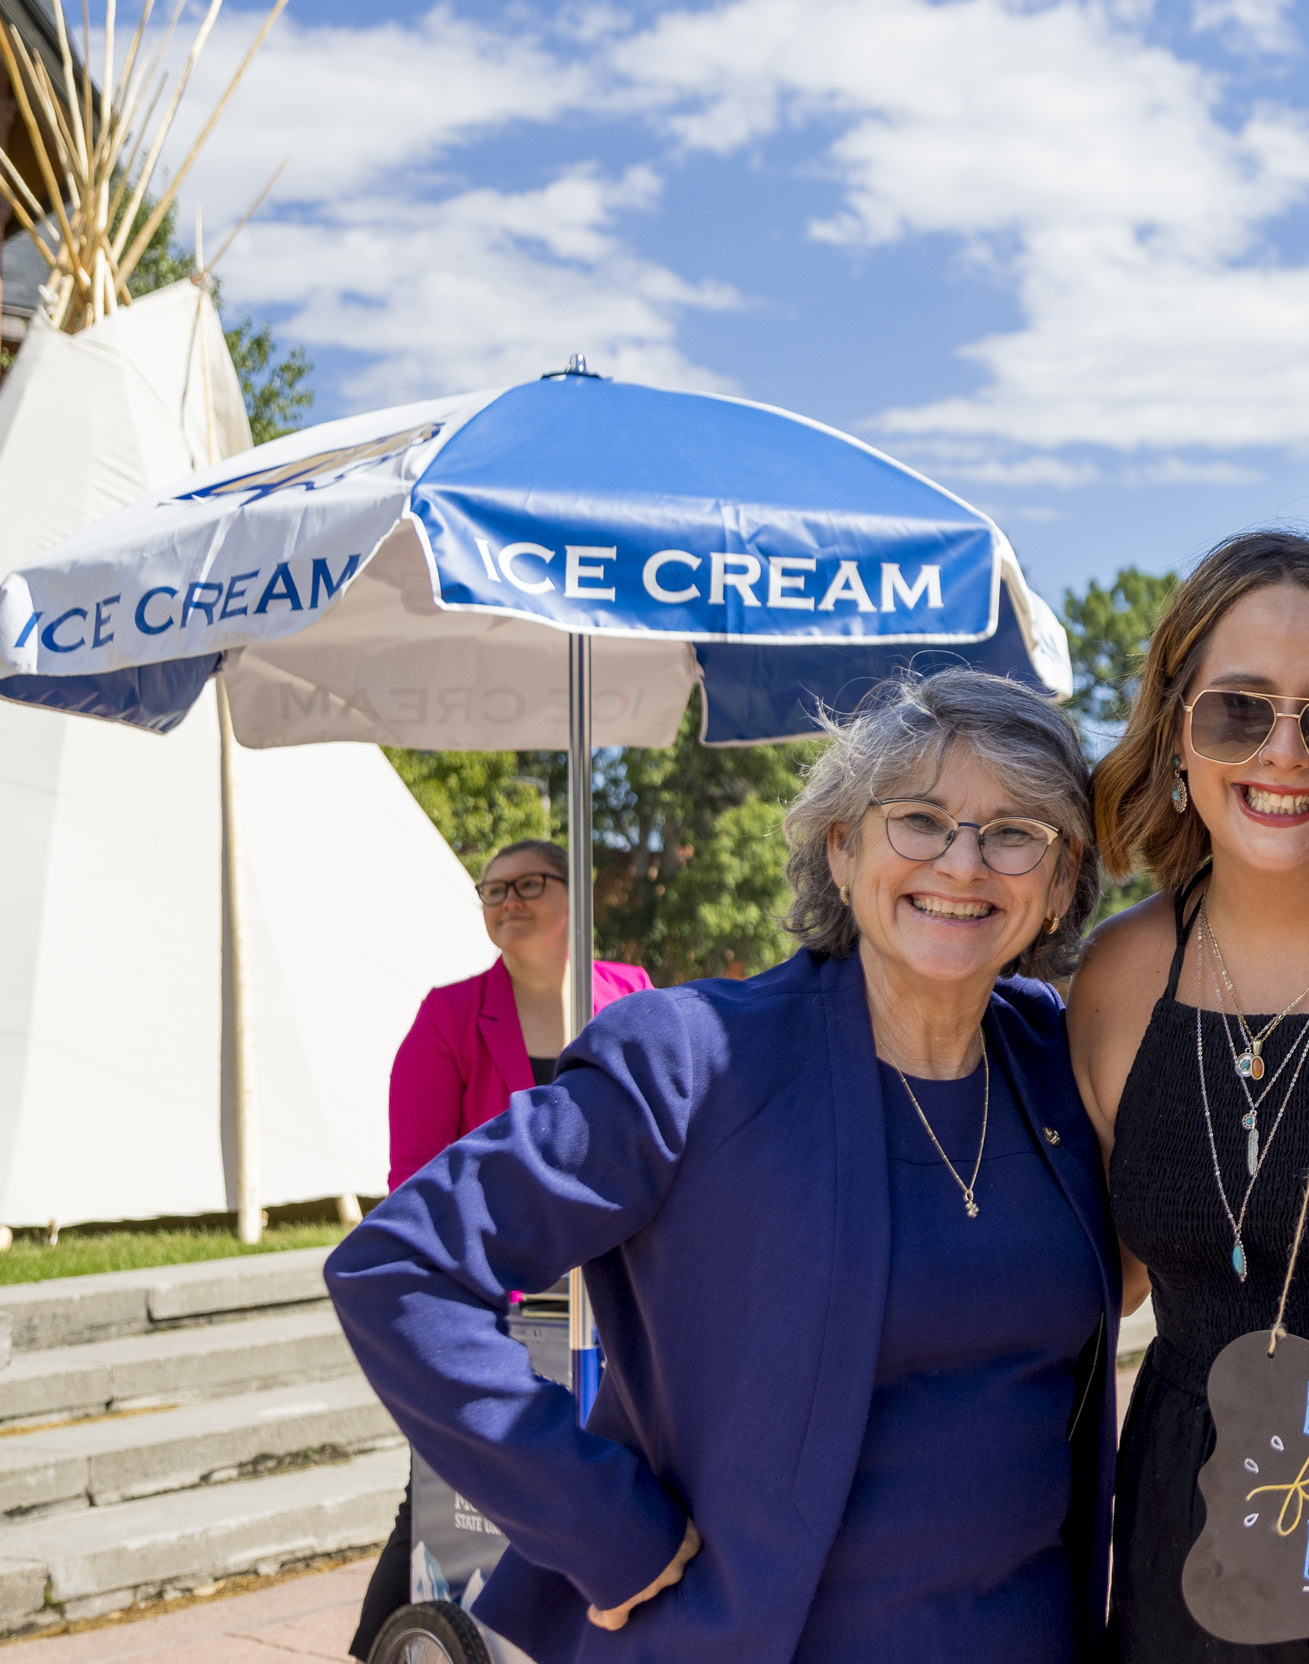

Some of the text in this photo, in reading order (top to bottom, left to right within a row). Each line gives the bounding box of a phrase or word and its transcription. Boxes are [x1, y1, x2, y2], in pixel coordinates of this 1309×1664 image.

[14, 553, 362, 653] ICE CREAM
[474, 537, 943, 613] ICE CREAM
[454, 1512, 483, 1533] STATE
